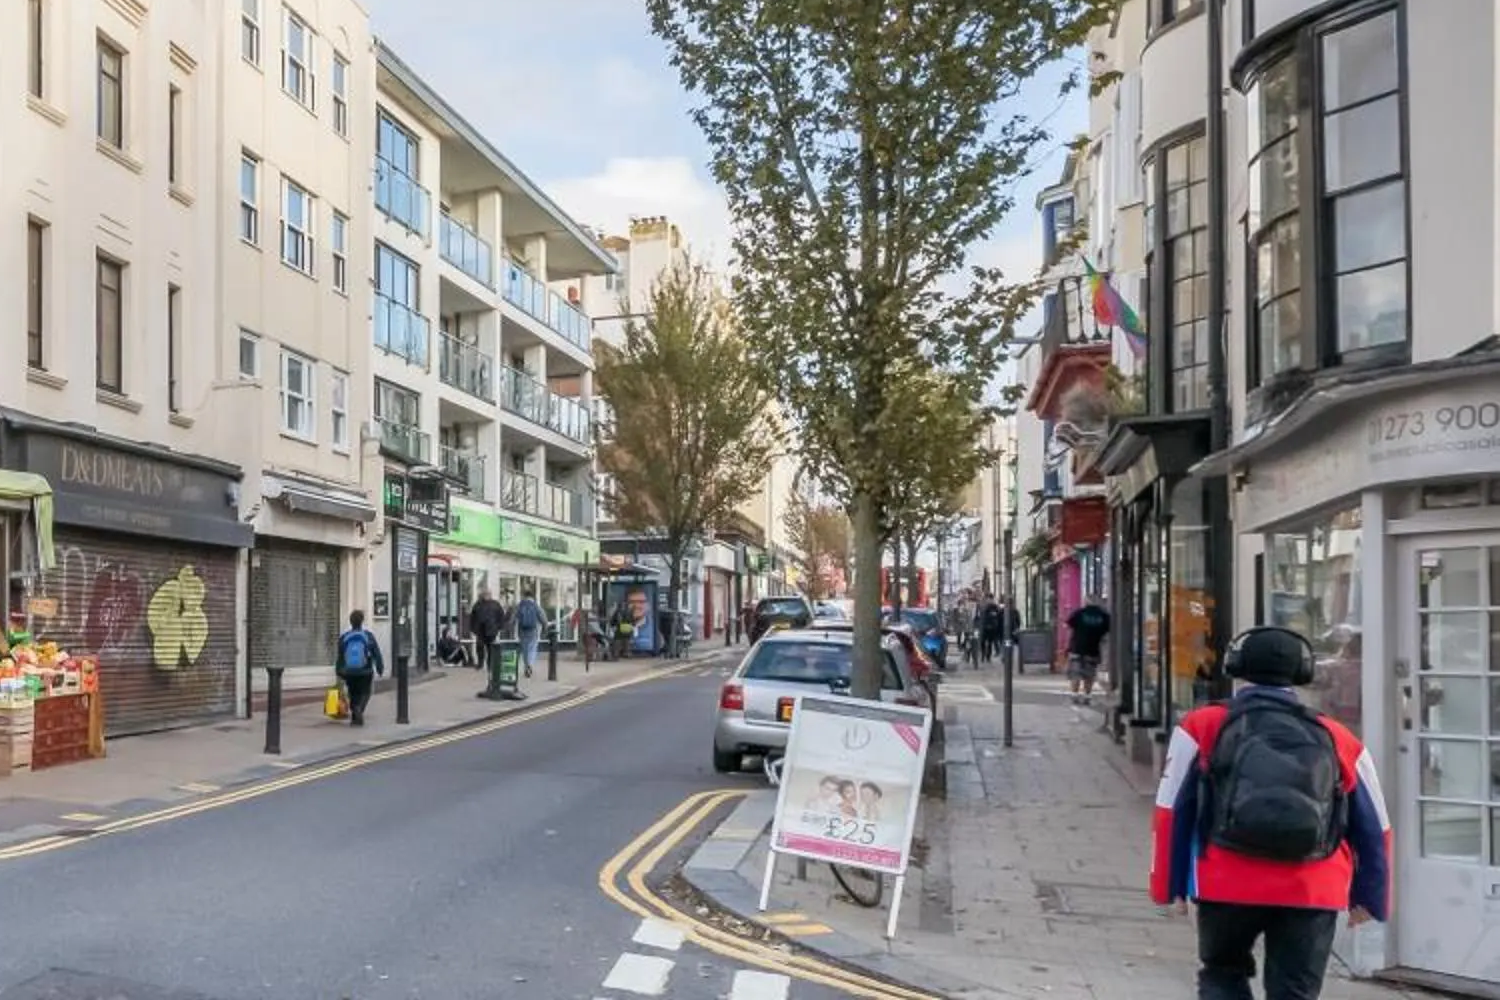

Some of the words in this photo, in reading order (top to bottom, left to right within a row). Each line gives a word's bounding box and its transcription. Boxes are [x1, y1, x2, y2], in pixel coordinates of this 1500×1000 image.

[1368, 411, 1425, 445] 01273
[1436, 402, 1500, 433] 900
[823, 817, 876, 845] £25
